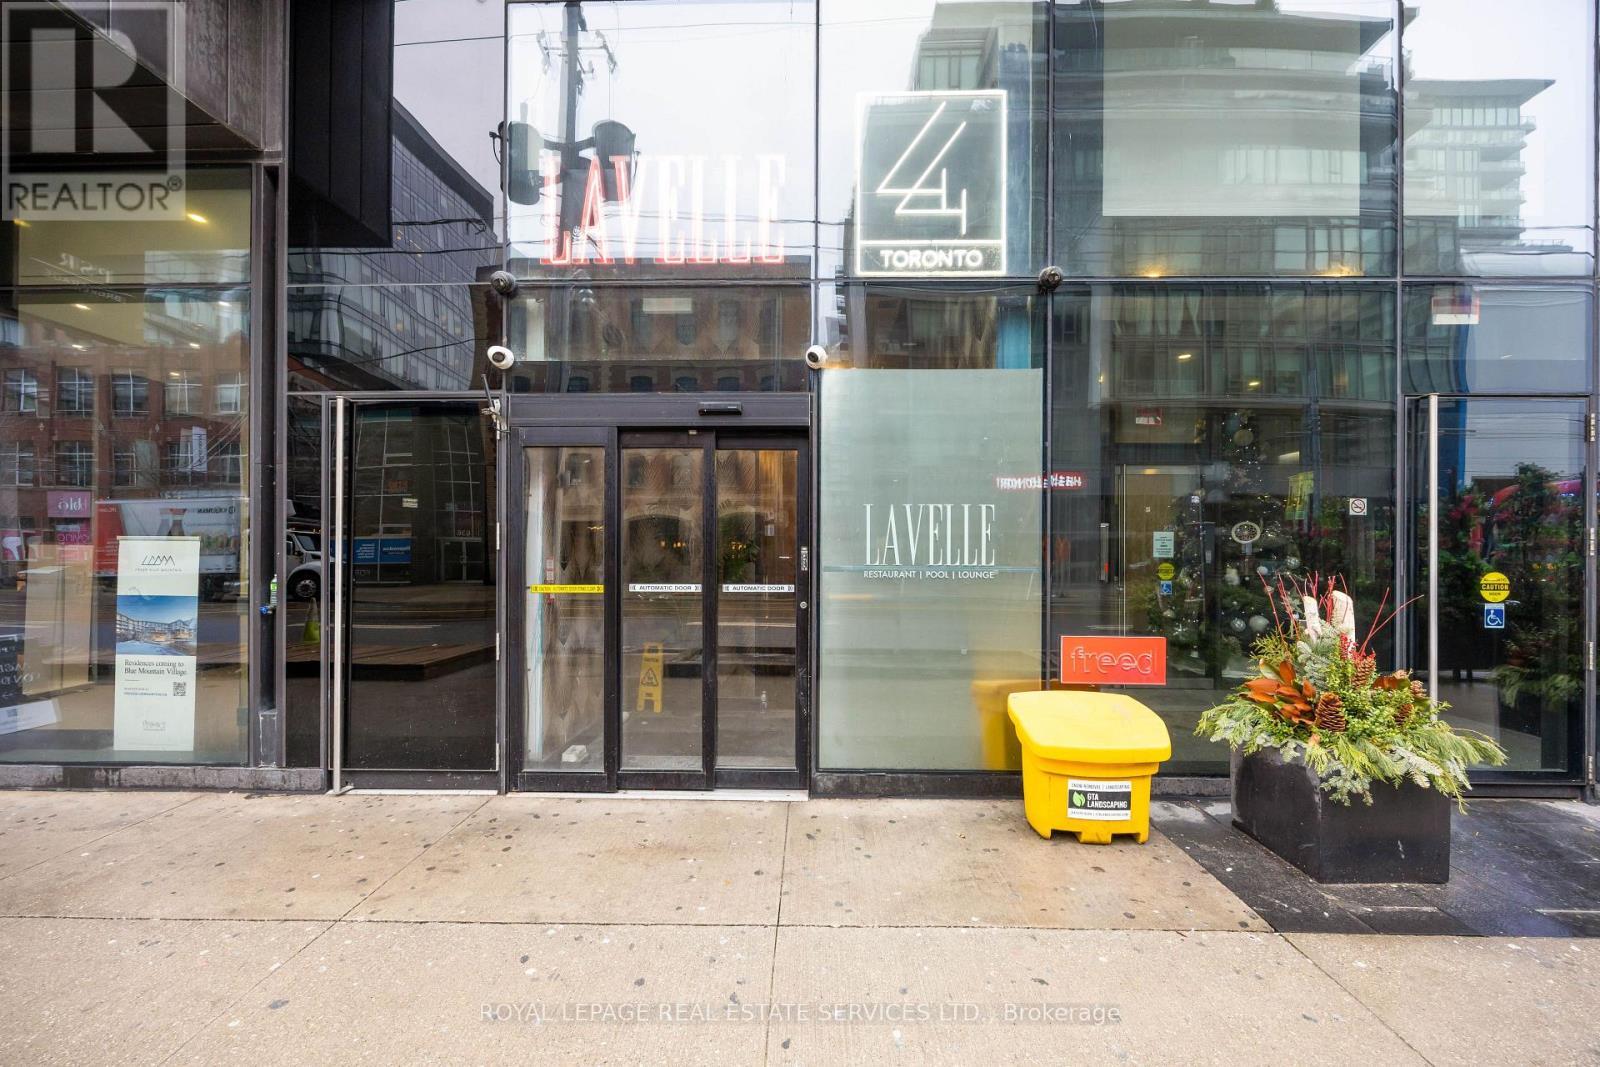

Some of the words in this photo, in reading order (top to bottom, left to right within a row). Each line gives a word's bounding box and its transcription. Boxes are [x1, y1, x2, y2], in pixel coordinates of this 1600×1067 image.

[540, 154, 786, 265] LAVELLE
[880, 250, 983, 267] TORONTO
[863, 503, 996, 566] LAVELLE
[863, 570, 917, 579] RESTAURANT
[925, 571, 949, 579] POOL
[958, 571, 996, 580] LOUNGE
[124, 658, 155, 667] Residences
[155, 660, 177, 669] coming
[1070, 646, 1157, 675] freed
[124, 666, 137, 675] Blue
[138, 667, 165, 675] Mountain
[166, 667, 188, 677] Village
[1087, 793, 1099, 801] GTA
